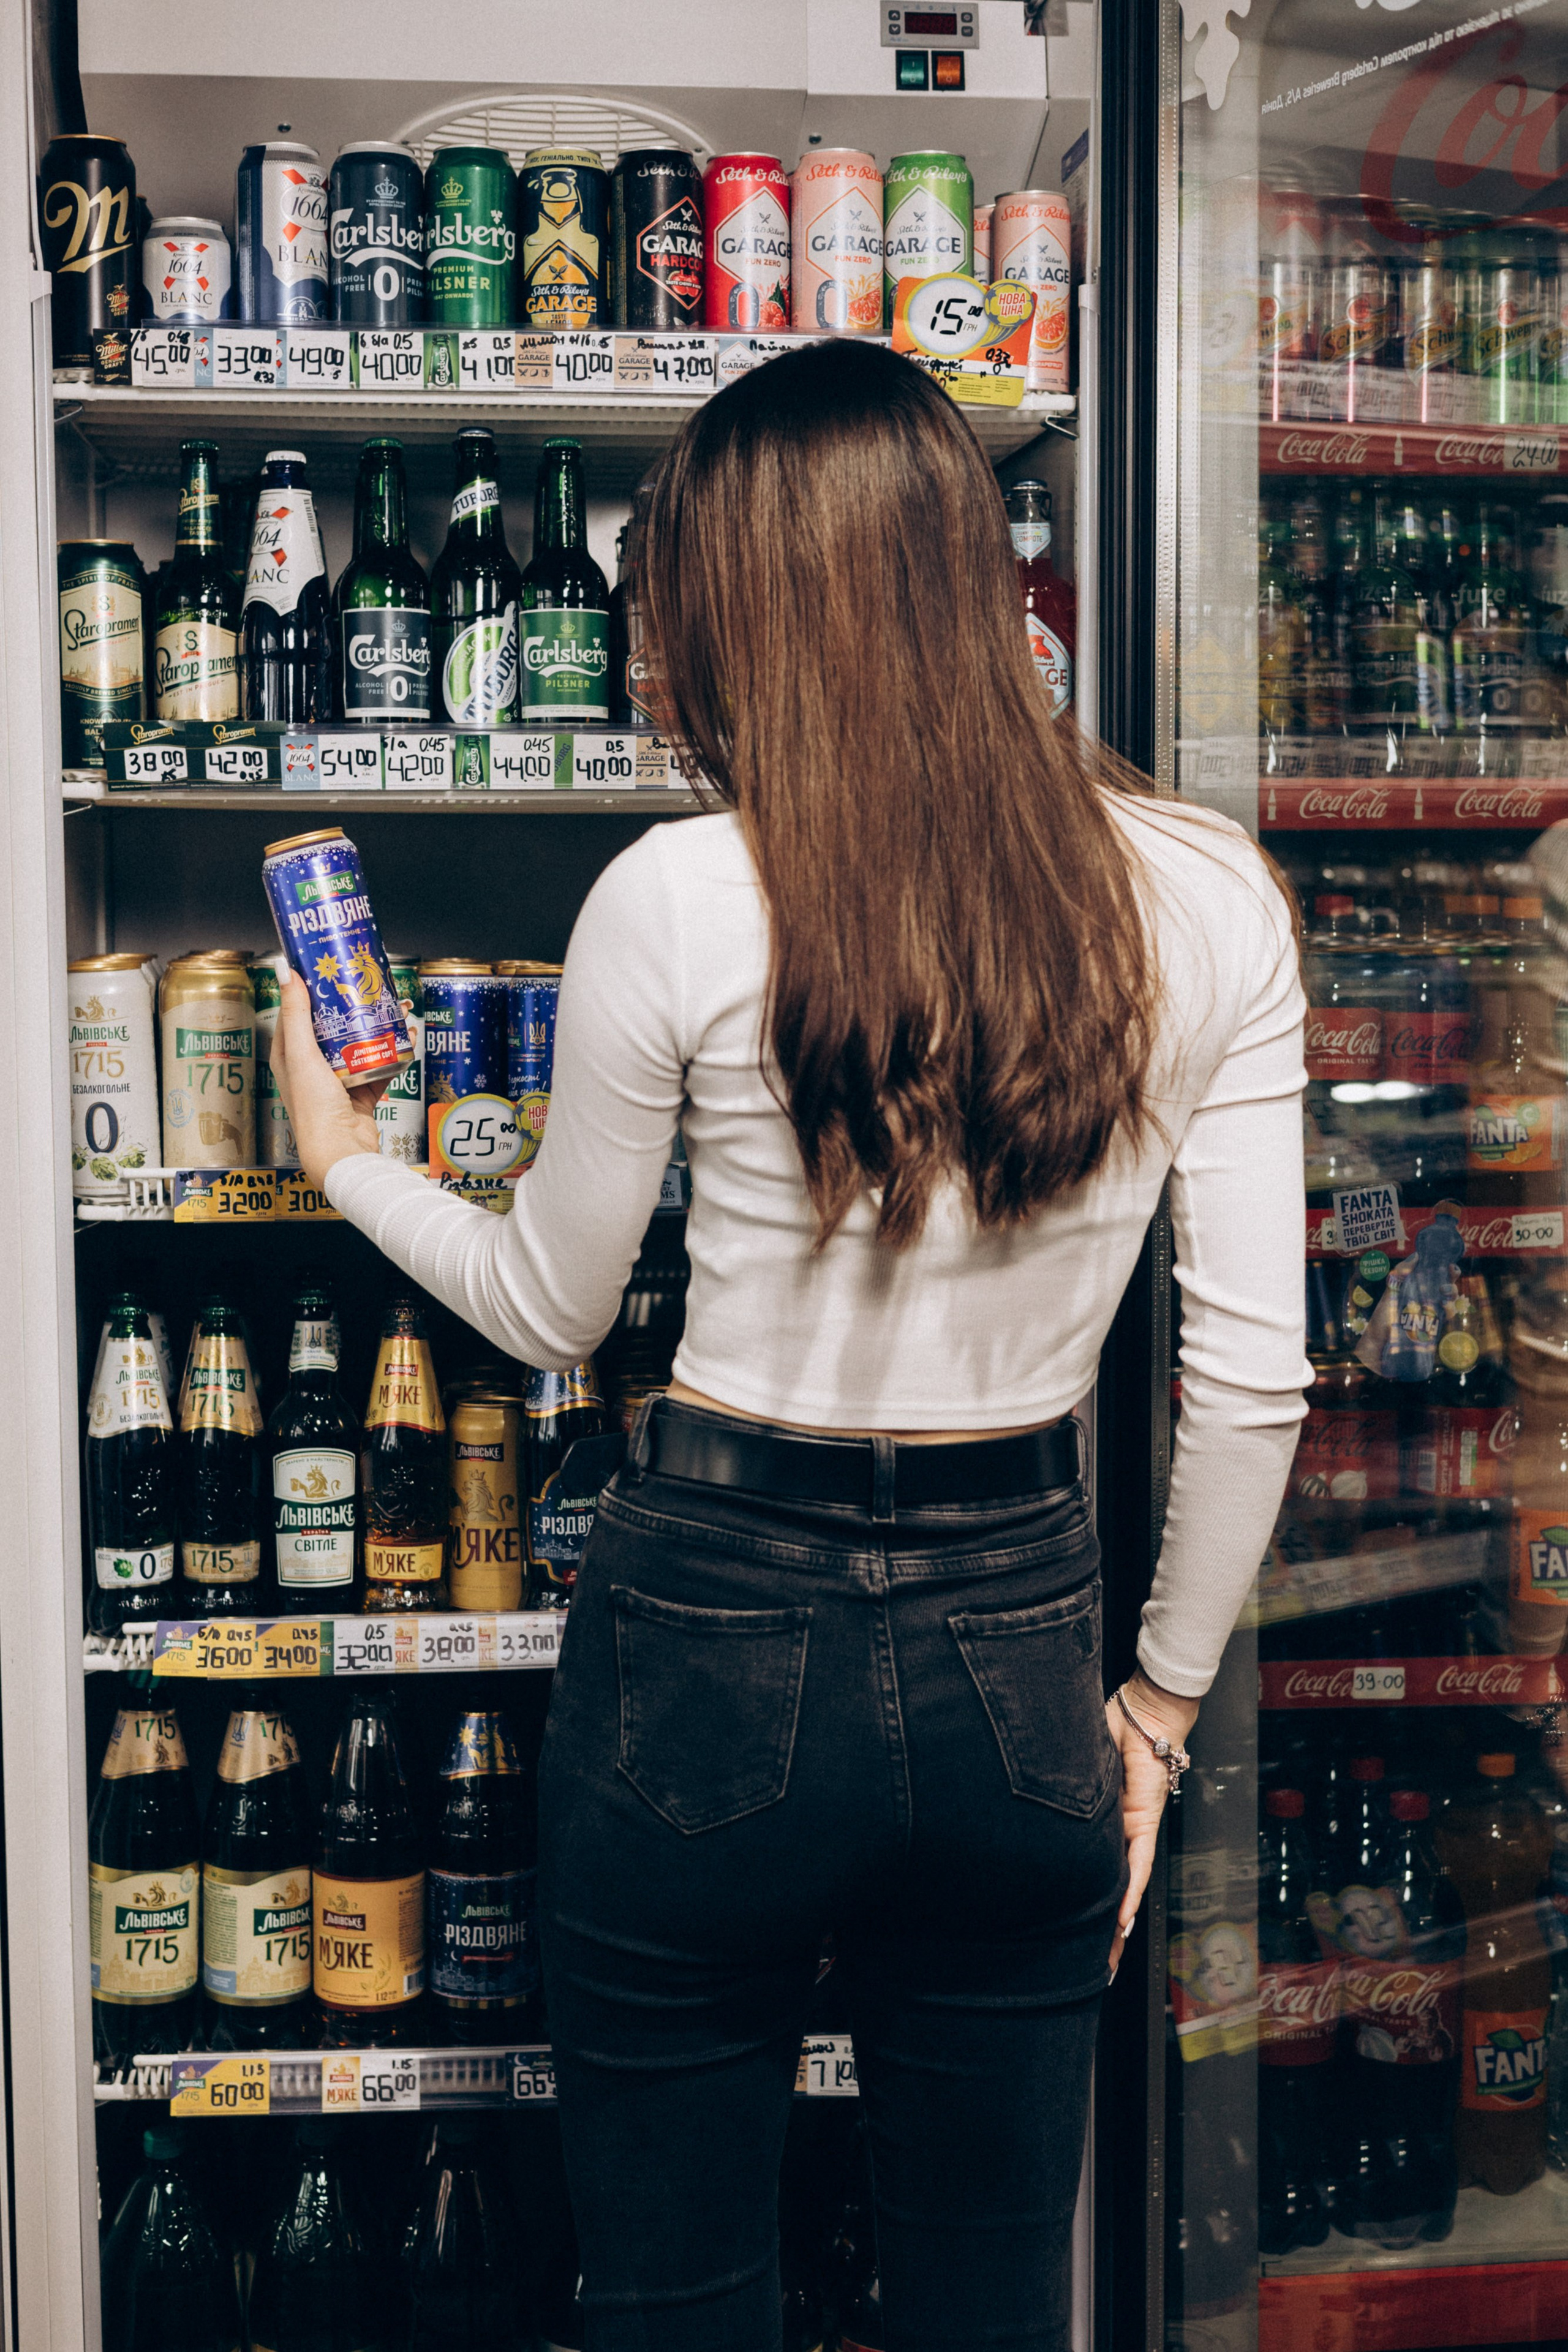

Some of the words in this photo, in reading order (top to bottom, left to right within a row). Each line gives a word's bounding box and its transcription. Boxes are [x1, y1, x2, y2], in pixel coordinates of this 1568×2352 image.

[716, 167, 752, 184] Seth
[754, 168, 766, 182] &
[806, 164, 844, 182] Seth
[846, 164, 858, 178] &
[908, 167, 921, 182] &
[1001, 206, 1028, 222] Seth
[643, 235, 703, 259] GARAG
[722, 238, 791, 259] GARAGE
[812, 235, 883, 255] GARAGE
[886, 236, 961, 257] GARAGE
[168, 260, 203, 273] 1664
[434, 265, 474, 274] PREMIUM
[764, 259, 781, 268] ZERO
[854, 256, 872, 265] ZERO
[373, 265, 399, 301] 0
[1005, 266, 1069, 284] GARAGE
[345, 284, 365, 292] FREE
[161, 291, 213, 305] BLANC
[526, 296, 597, 313] GARAGE
[998, 292, 1027, 305] НОВА
[1001, 303, 1023, 317] ЦІНА
[963, 323, 978, 332] ГРН
[96, 343, 129, 360] Miller
[100, 356, 126, 366] GENUINE
[435, 346, 450, 386] Carlsberg
[1277, 431, 1372, 465] Coca-Cola
[64, 609, 140, 651] Staropramen
[524, 636, 608, 673] Carlsberg
[390, 676, 409, 701] 0
[545, 680, 590, 688] PILSNER
[130, 724, 175, 745] Staropramen
[213, 724, 256, 745] Staropramen
[289, 753, 311, 764] 1664
[285, 772, 318, 782] BLANC
[1299, 788, 1392, 820] Coca-Cola
[1455, 787, 1547, 819] Coca-Cola
[288, 895, 374, 938] РІЗДВЯНЕ
[318, 933, 338, 944] ПИВО
[339, 928, 361, 938] ТЕМНЕ
[69, 1025, 130, 1042] ЛЬВІВСЬКЕ
[179, 1032, 251, 1054] ЛЬВІВСЬКЕ
[352, 1041, 389, 1059] ЛІМІТОВАНИЙ
[74, 1050, 124, 1080] 1715
[350, 1054, 381, 1067] СВЯТКОВИЙ
[382, 1050, 394, 1060] СОРТ
[187, 1063, 244, 1095] 1715
[72, 1082, 131, 1095] БЕЗАЛКОГОЛЬНЕ
[85, 1101, 119, 1154] 0
[1470, 1117, 1529, 1145] FANTA
[498, 1141, 512, 1152] ГРН
[187, 1199, 207, 1208] 1715
[1340, 1189, 1393, 1214] FANTA
[1341, 1206, 1394, 1227] SHOKATA
[1343, 1219, 1395, 1237] ПЕРЕВЕРТАЄ
[1374, 1227, 1396, 1242] СВІТ
[1363, 1257, 1386, 1267] ФІШКА
[1364, 1265, 1387, 1275] СЕЗОНУ
[190, 1370, 244, 1389] ЛЬВІВСЬКЕ
[379, 1382, 422, 1408] М'ЯКЕ
[192, 1392, 235, 1419] 1715
[456, 1444, 500, 1460] ЛЬВІВСЬКЕ
[557, 1495, 597, 1512] ЛЬВІВСЬКЕ
[275, 1503, 356, 1529] ЛЬВІВСЬКЕ
[295, 1537, 337, 1552] СВІТЛЕ
[140, 1552, 157, 1580] 0
[192, 1549, 235, 1574] 1715
[373, 1550, 417, 1577] М'ЯКЕ
[167, 1651, 186, 1662] 1715
[1436, 1664, 1528, 1695] Coca-Cola
[135, 1716, 176, 1741] 1715
[119, 1908, 187, 1931] ЛЬВІВСЬКЕ
[461, 1904, 511, 1919] ЛЬВІВСЬКЕ
[323, 1914, 364, 1929] ЛЬВІВСЬКЕ
[444, 1921, 527, 1951] РІЗДВЯНЕ
[126, 1935, 179, 1967] 1715
[265, 1931, 311, 1967] 1715
[318, 1934, 374, 1972] М'ЯКЕ
[181, 2090, 200, 2101] 1715
[326, 2087, 358, 2104] М'ЯКЕ
